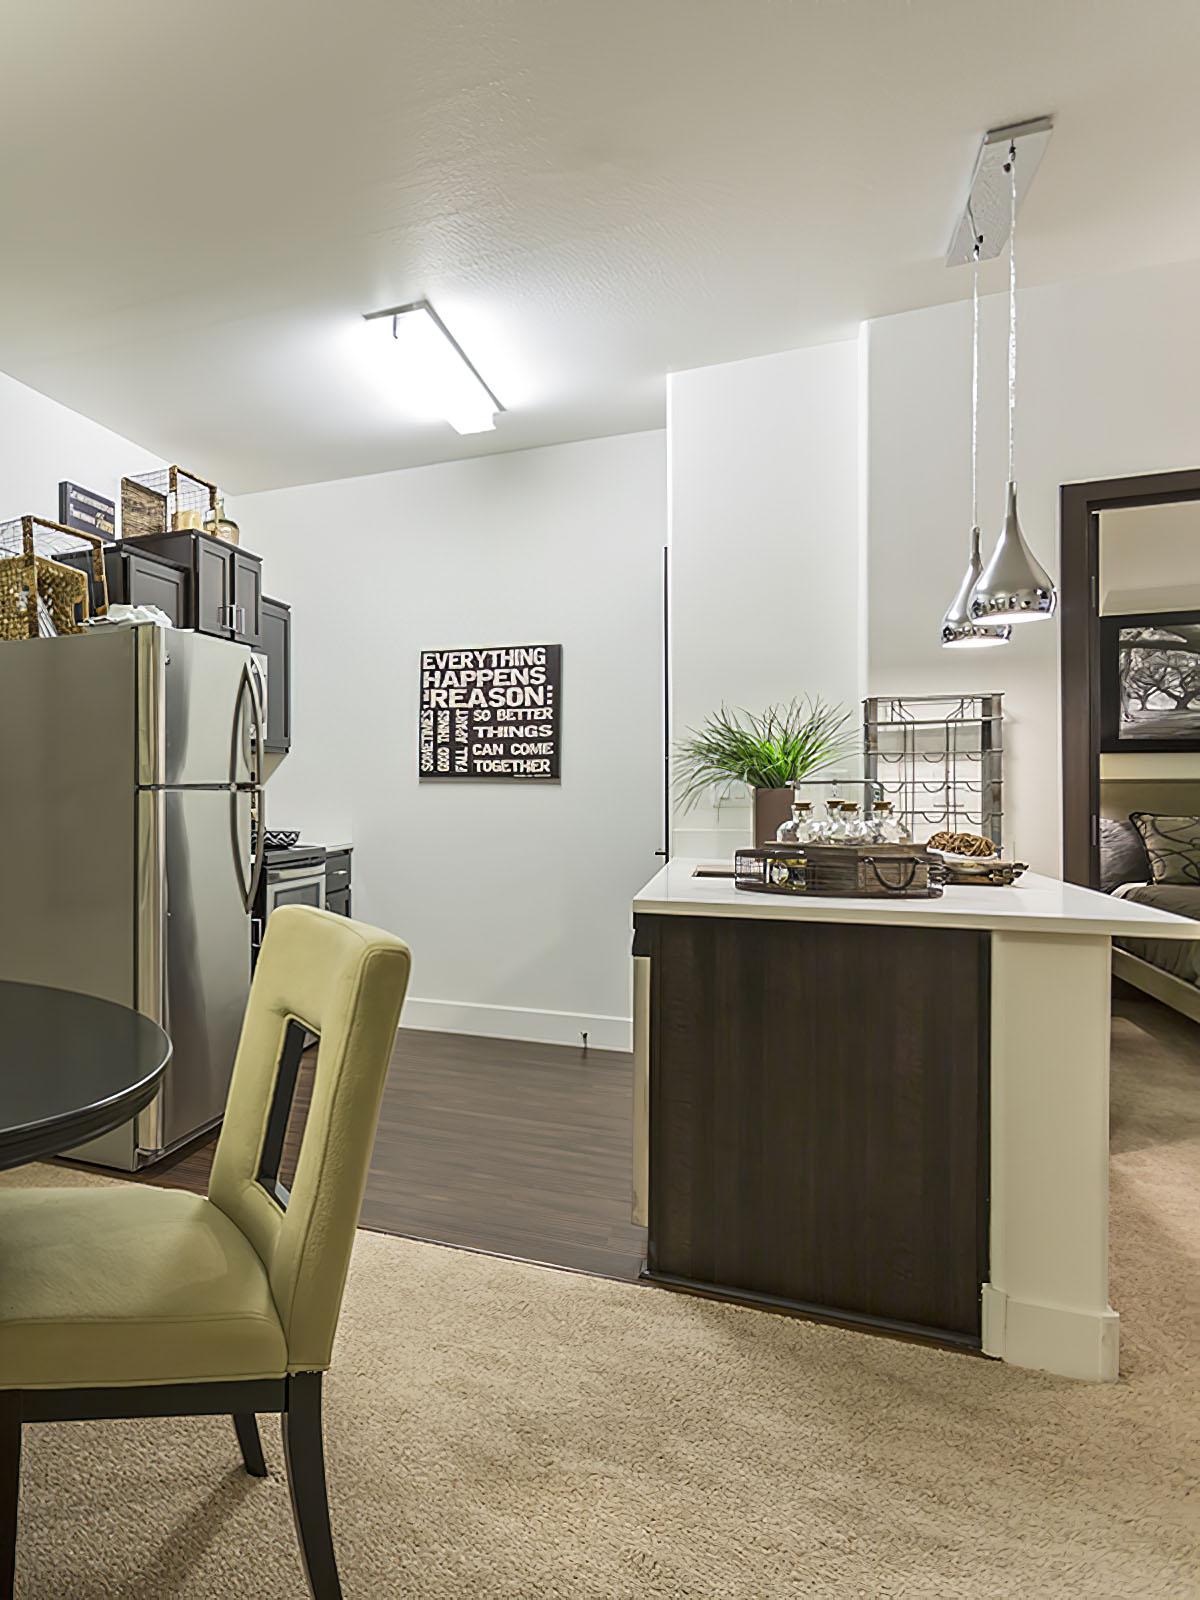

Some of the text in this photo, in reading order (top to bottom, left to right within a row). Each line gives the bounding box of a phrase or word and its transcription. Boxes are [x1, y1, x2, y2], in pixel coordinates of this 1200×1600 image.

[422, 648, 546, 669] EVERYTHING
[422, 667, 546, 688] HAPPENS
[473, 707, 554, 722] SO BETTER
[437, 710, 450, 744] THINGS
[472, 724, 554, 738] THINGS
[421, 709, 434, 772] SOMETIMES
[455, 708, 469, 773] FALL APART
[472, 742, 554, 756] CAN COME
[473, 758, 551, 773] TOGETHER
